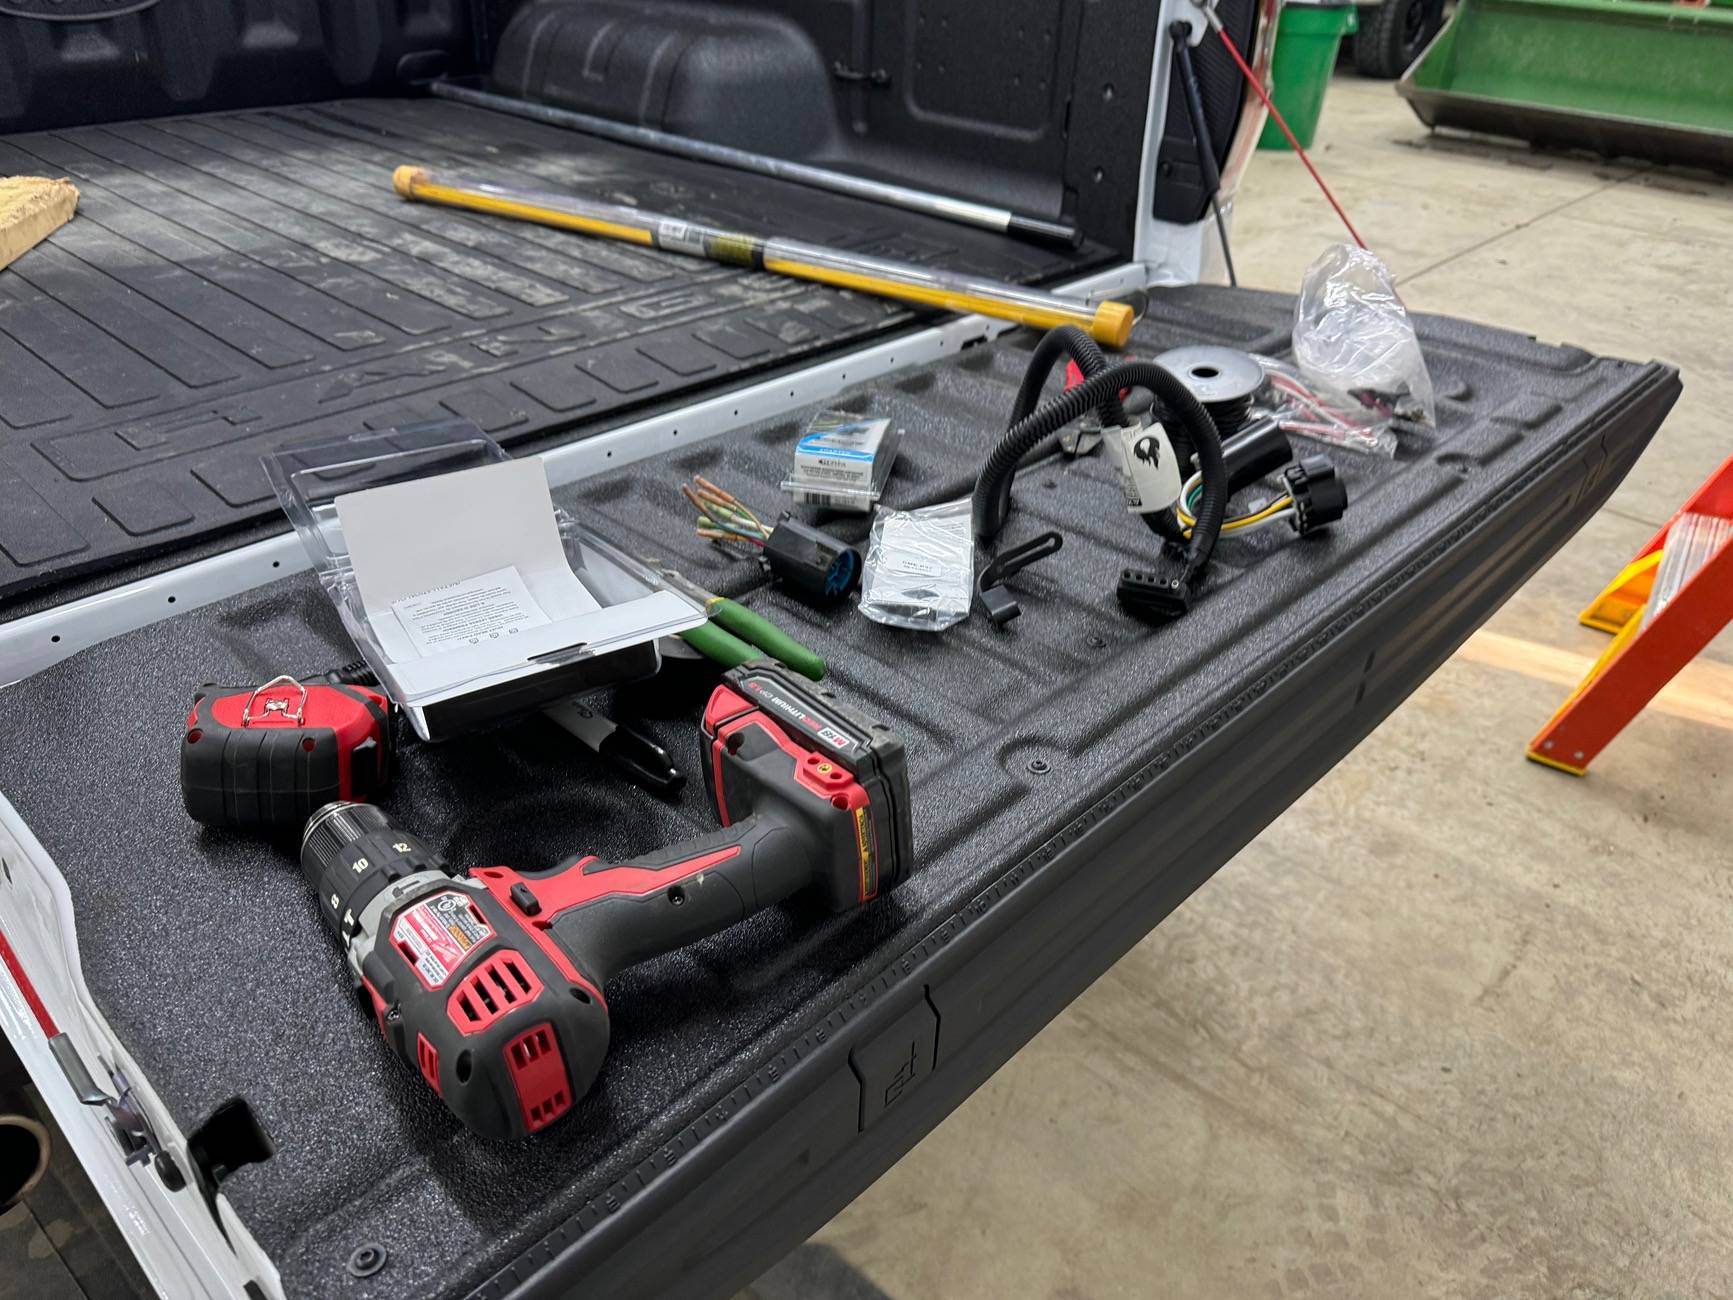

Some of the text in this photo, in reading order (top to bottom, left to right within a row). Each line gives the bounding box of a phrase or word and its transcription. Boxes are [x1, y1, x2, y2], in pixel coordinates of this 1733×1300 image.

[820, 730, 847, 747] M18
[392, 842, 412, 853] 12
[352, 858, 369, 874] 10
[330, 893, 340, 910] 8
